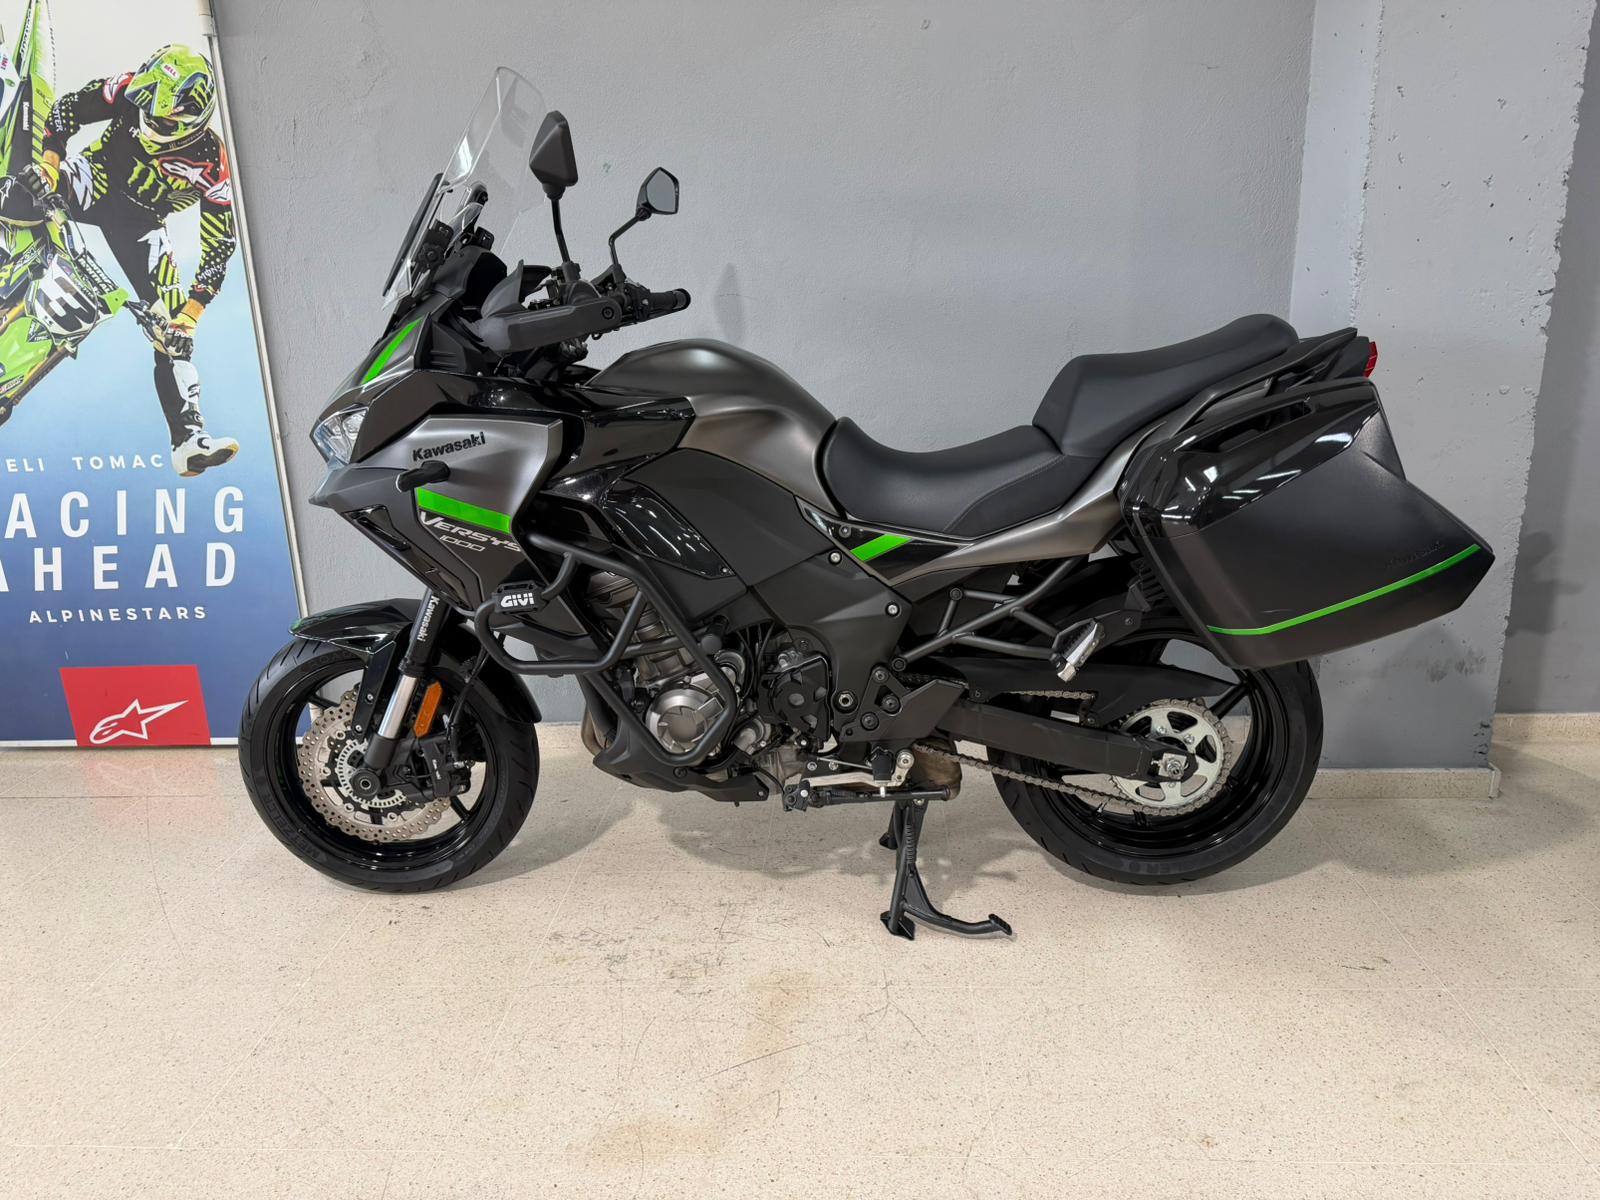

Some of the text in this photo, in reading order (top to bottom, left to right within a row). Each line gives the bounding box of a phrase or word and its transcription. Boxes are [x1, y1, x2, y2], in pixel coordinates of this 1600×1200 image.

[412, 431, 486, 462] Kawasaki
[6, 454, 165, 473] ELI TOMAC
[4, 486, 244, 539] ACING
[420, 511, 521, 552] VERSYS
[440, 534, 486, 552] 1000
[500, 592, 535, 608] GIVI
[29, 606, 207, 624] ALPINESTARS
[416, 595, 441, 643] Kawasaki
